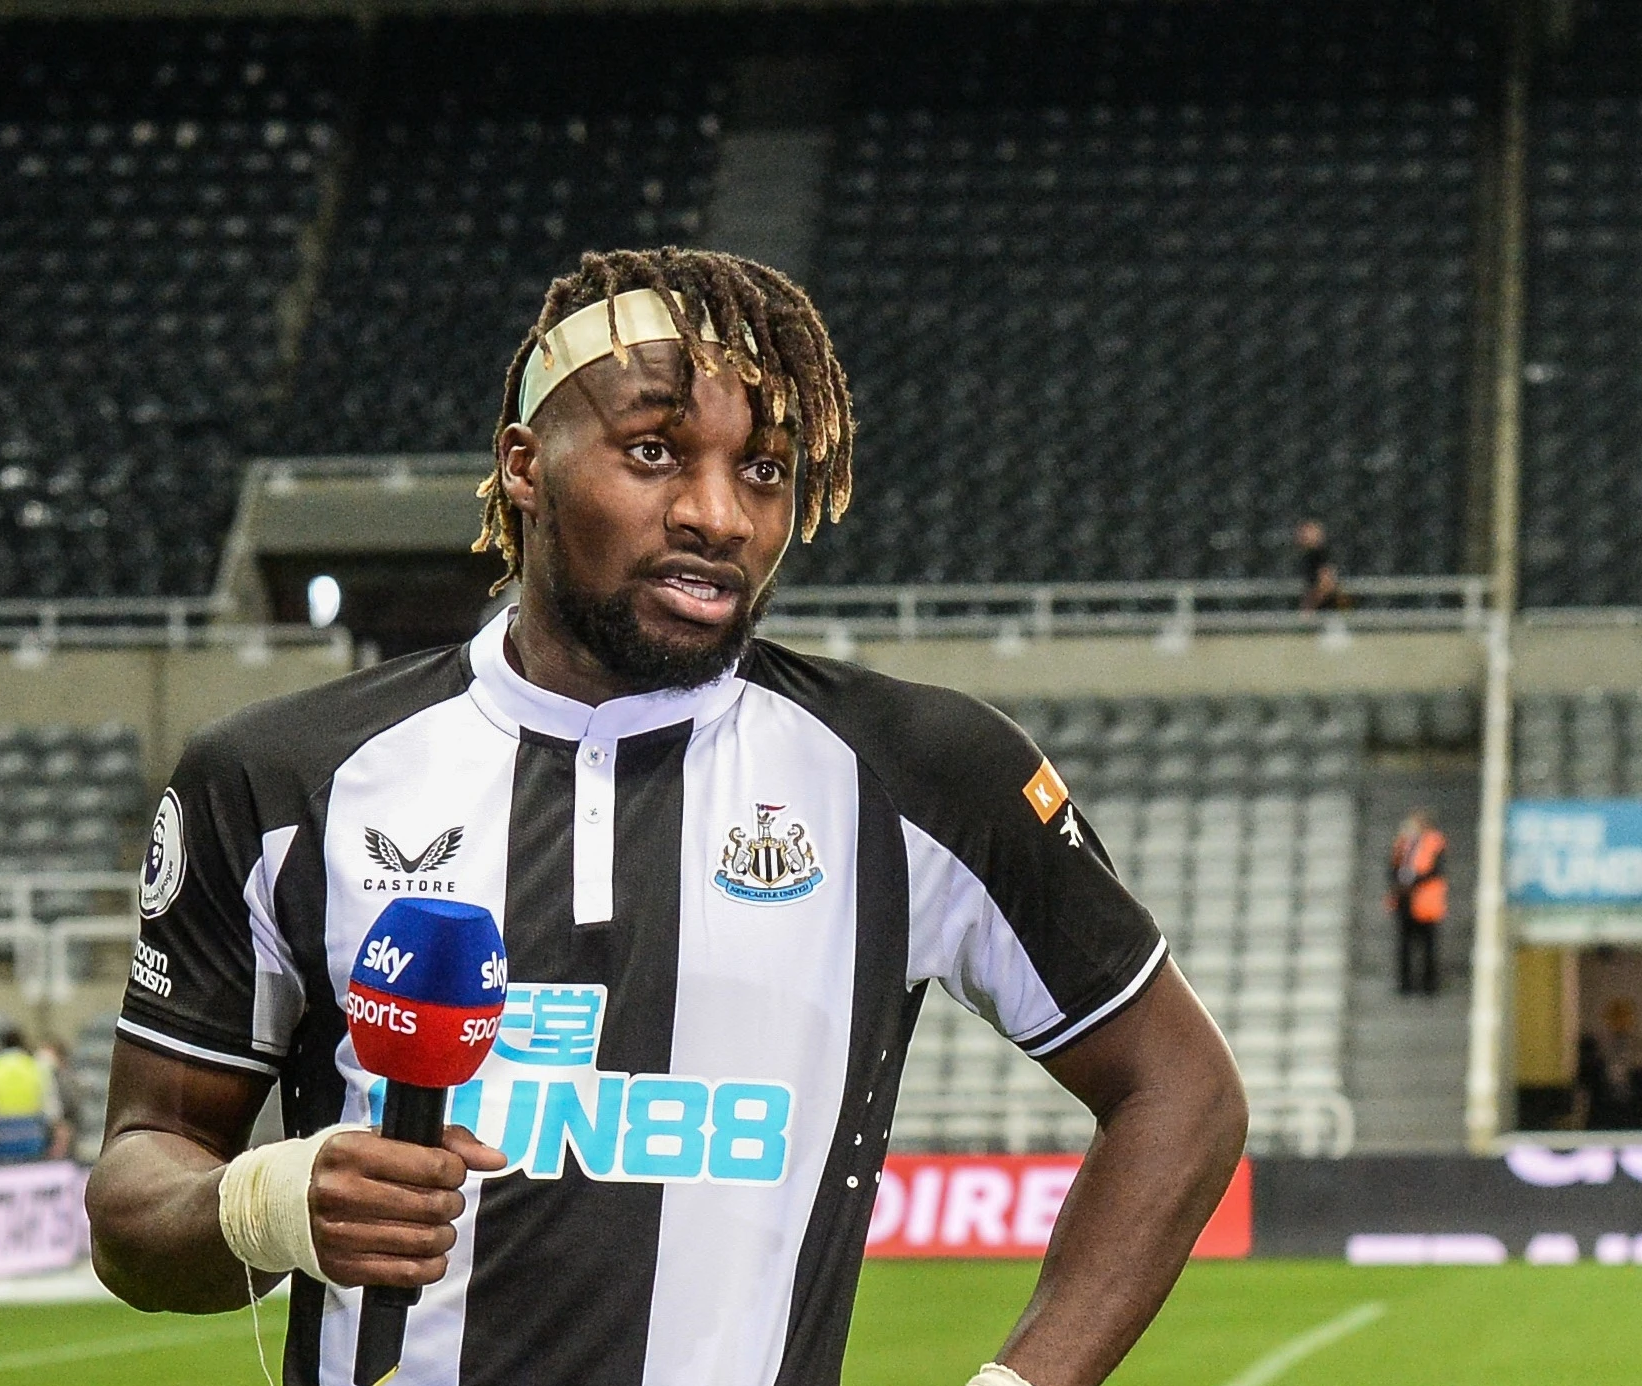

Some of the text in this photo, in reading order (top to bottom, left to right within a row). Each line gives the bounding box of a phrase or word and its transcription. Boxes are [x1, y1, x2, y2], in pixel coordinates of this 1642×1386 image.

[363, 878, 456, 893] CASTORE
[729, 884, 809, 899] NEWCASTLE UNITED
[363, 936, 414, 983] sky
[347, 991, 417, 1035] sports
[369, 1077, 793, 1182] UN88
